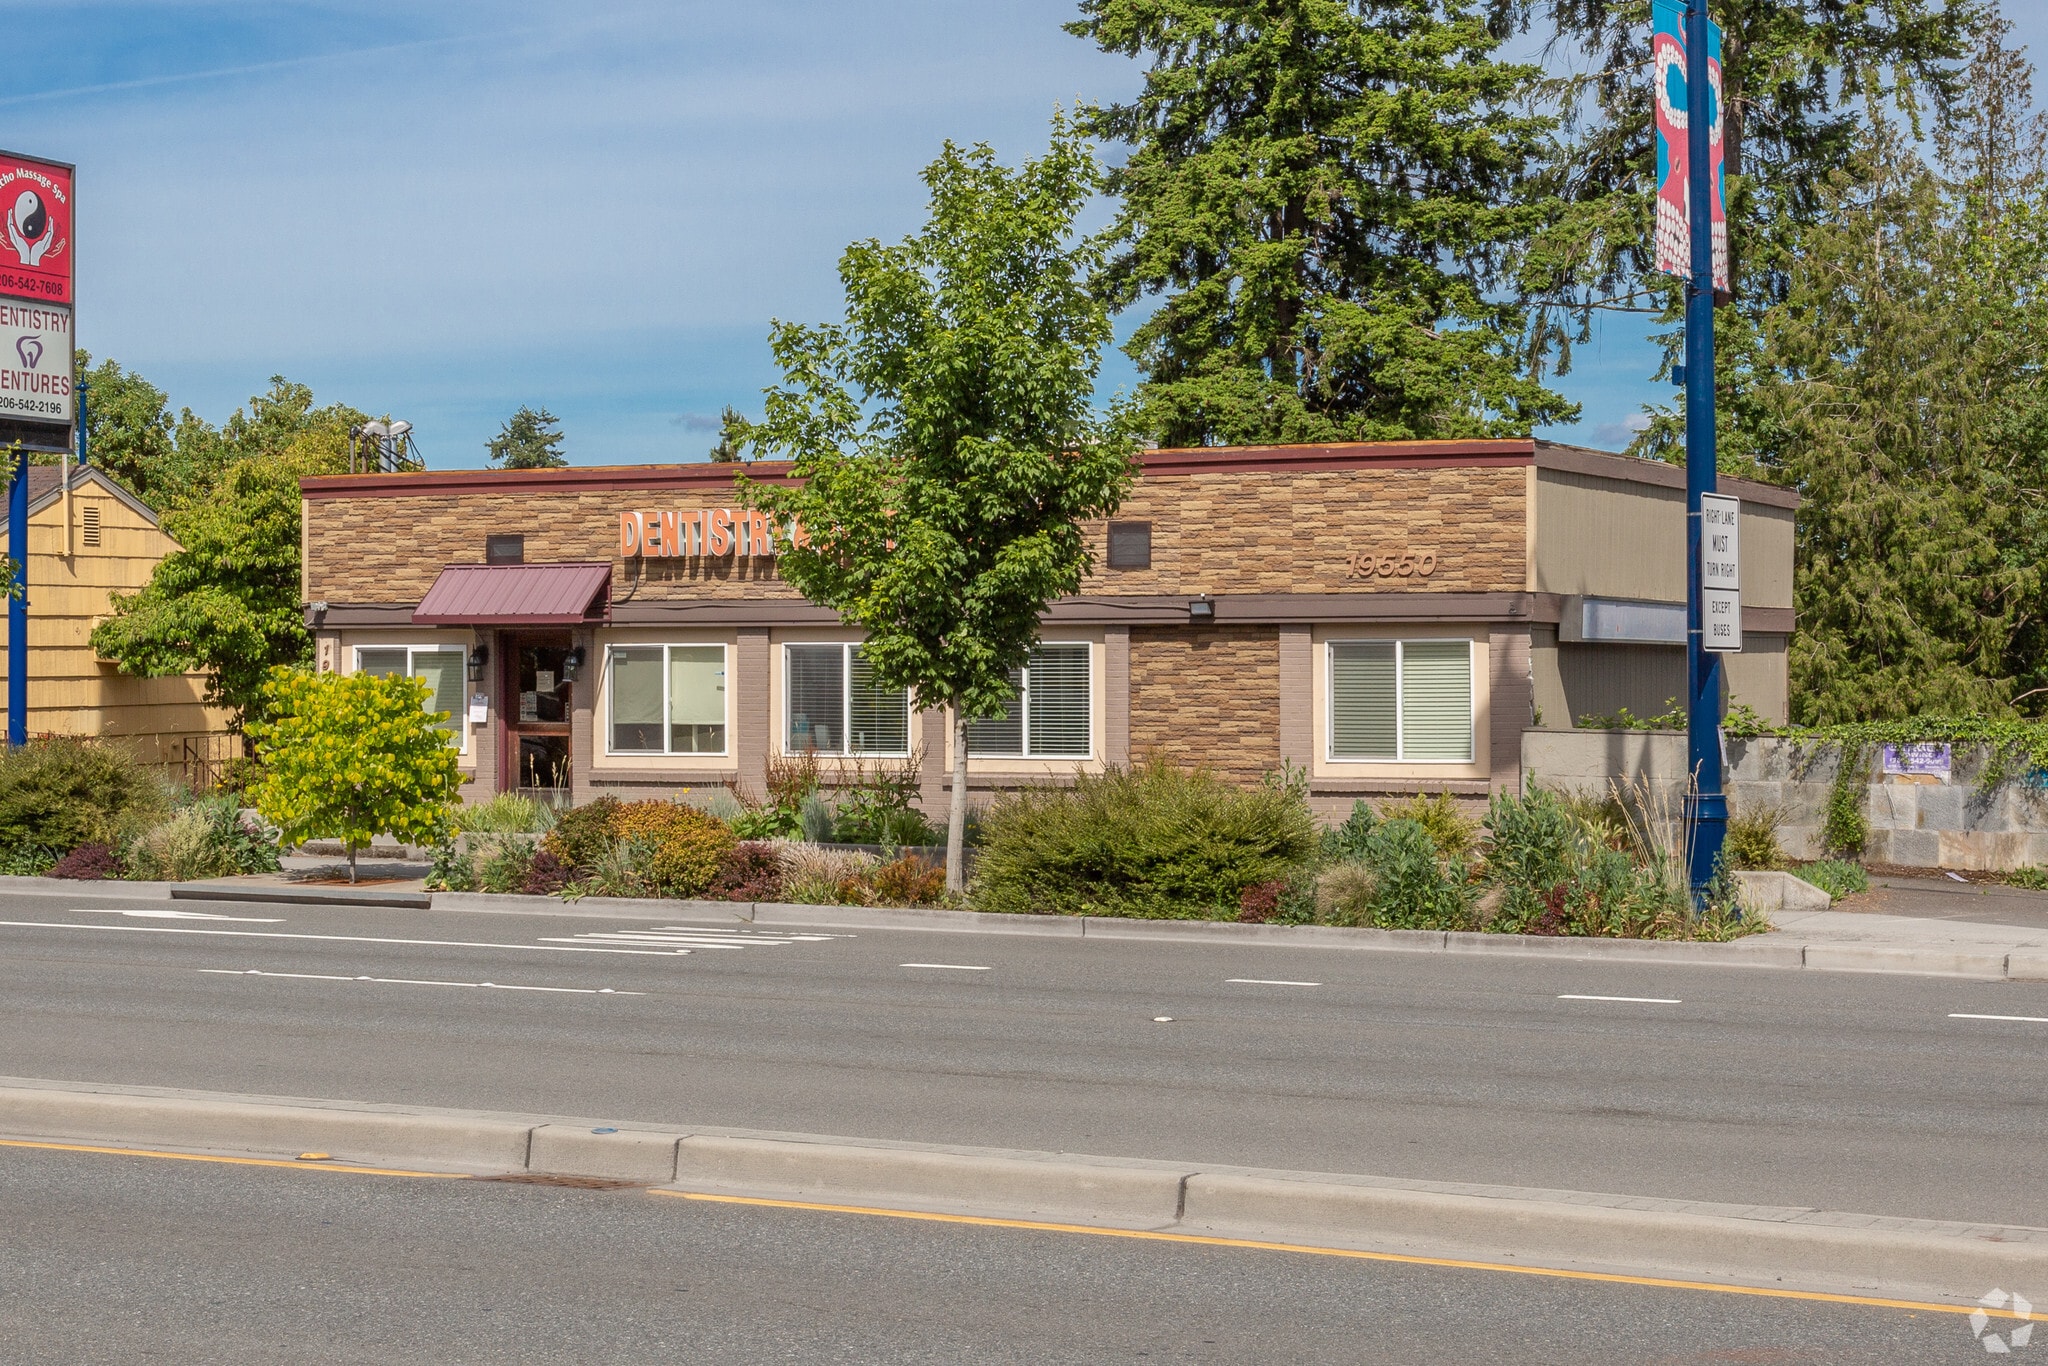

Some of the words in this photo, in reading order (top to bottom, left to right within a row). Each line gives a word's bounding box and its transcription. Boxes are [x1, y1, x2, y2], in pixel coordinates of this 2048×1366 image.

[0, 173, 15, 189] cho
[16, 167, 52, 189] Massage
[52, 184, 66, 204] Spa
[0, 305, 69, 333] ENTISTRY
[1, 369, 70, 396] ENTURES
[1706, 508, 1720, 524] RIGHT
[1721, 510, 1735, 526] LANE
[1712, 534, 1729, 552] MUST
[1345, 553, 1438, 578] 19550
[1706, 561, 1719, 577] TURN
[1720, 563, 1736, 578] RIGHT
[1712, 600, 1731, 614] EXCEPT
[1713, 623, 1731, 637] BUSES
